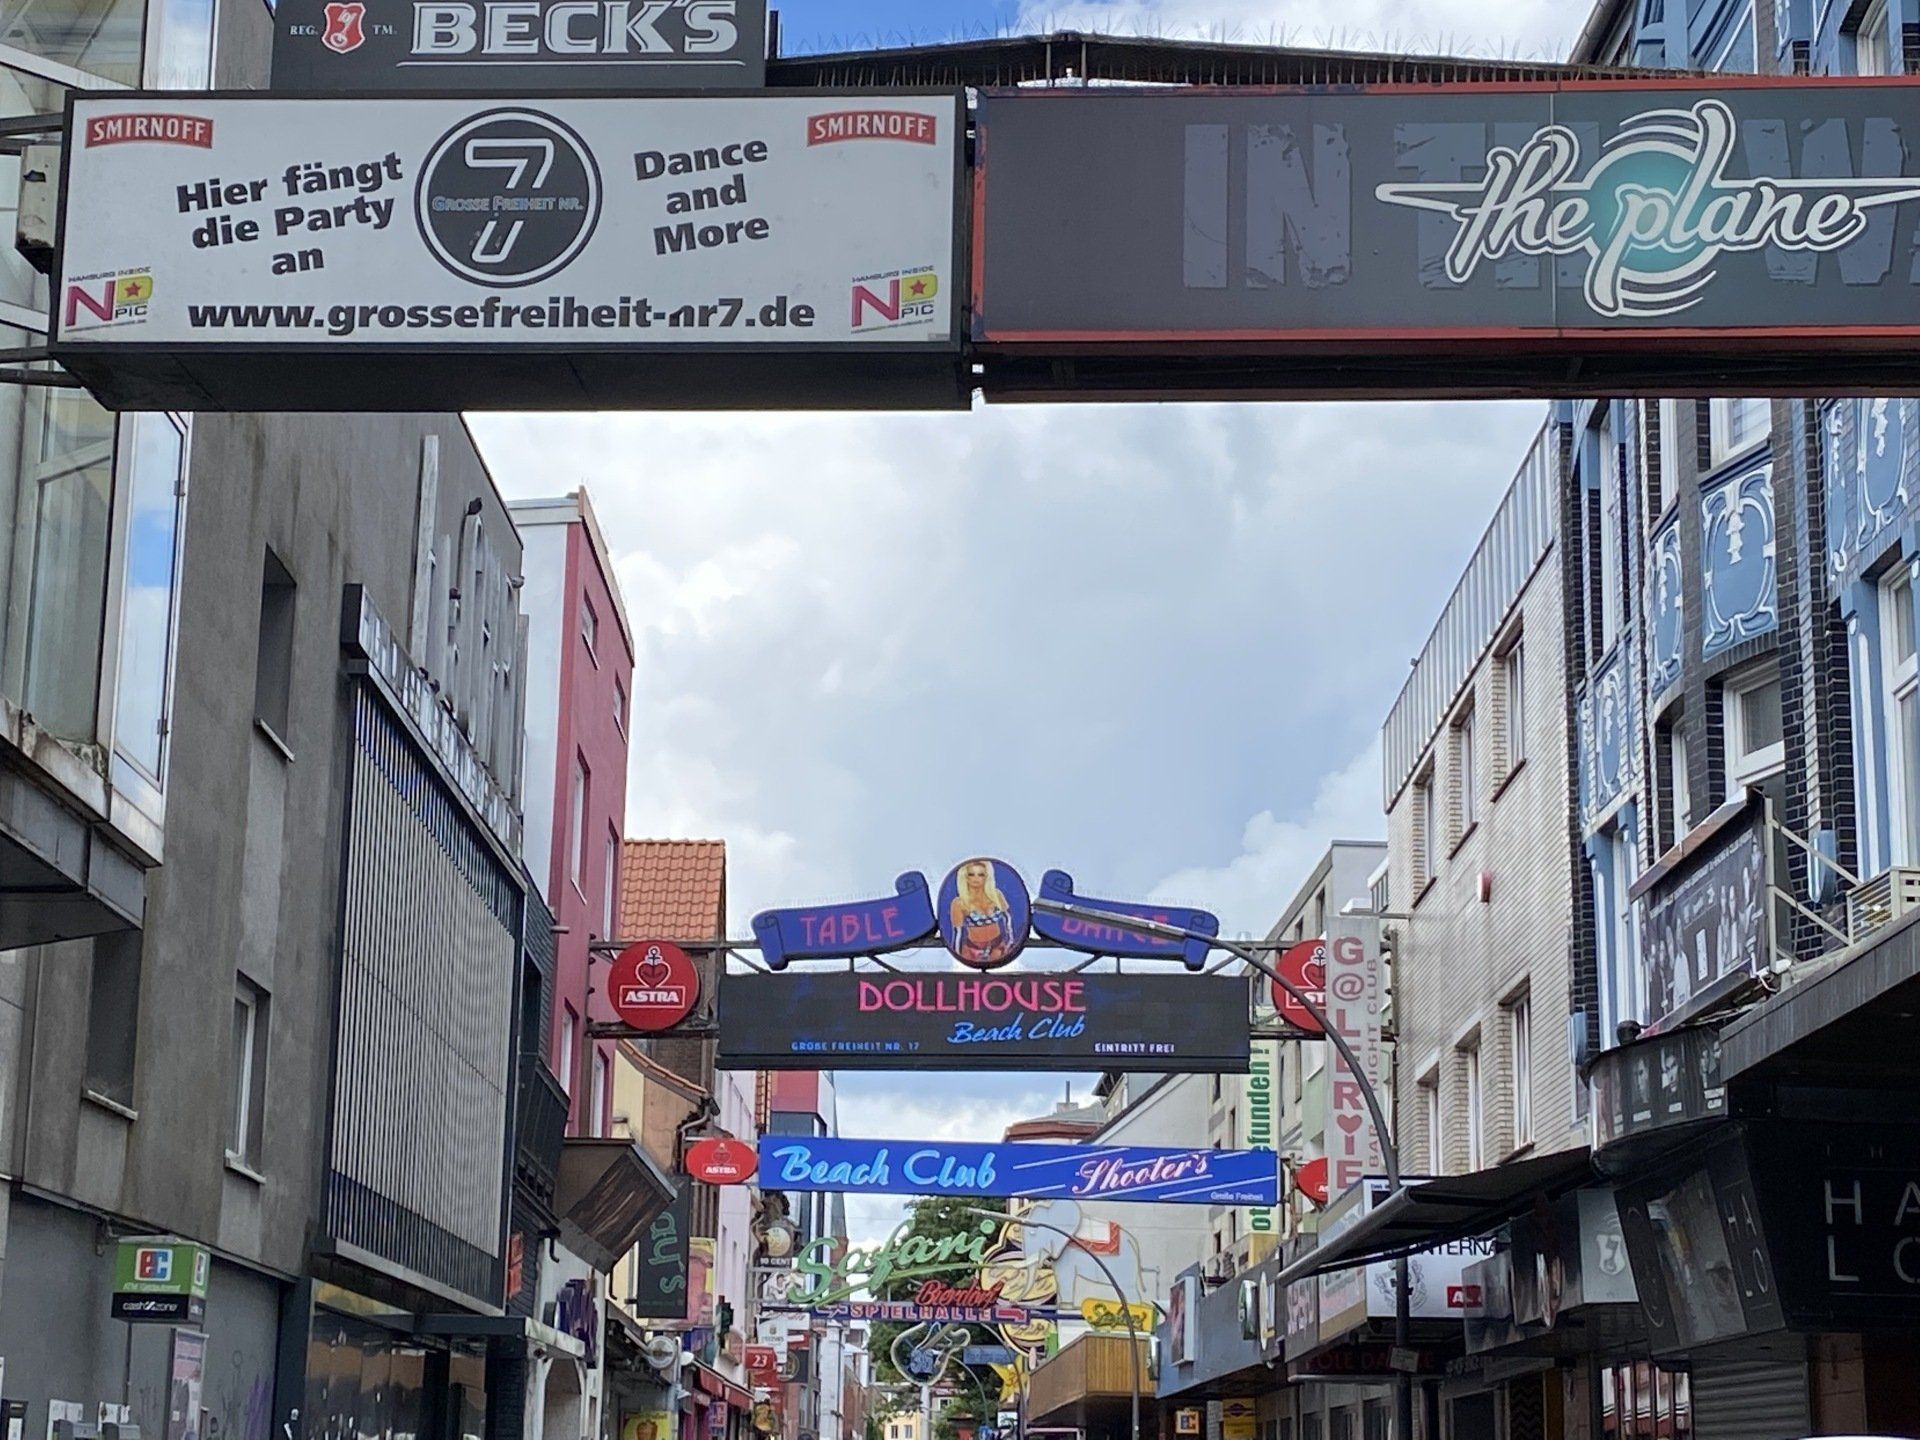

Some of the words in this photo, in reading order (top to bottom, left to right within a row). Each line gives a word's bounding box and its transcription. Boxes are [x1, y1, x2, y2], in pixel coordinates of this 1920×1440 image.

[410, 0, 738, 54] BECK'S
[92, 116, 207, 142] SMIRNOFF
[814, 113, 928, 140] SMIRNOFF
[634, 139, 769, 181] Dance
[176, 178, 269, 214] Hier
[282, 151, 403, 197] fängt
[666, 174, 748, 215] and
[191, 217, 260, 249] die
[274, 195, 395, 238] Party
[1184, 122, 1352, 290] IN
[1445, 126, 1592, 283] the
[1586, 99, 1867, 318] plane
[653, 216, 770, 256] More
[270, 246, 325, 276] an
[188, 296, 816, 337] www.grossefreiheit-nr7.de
[800, 907, 905, 947] TABLE
[625, 990, 680, 1004] ASTRA
[859, 980, 1086, 1013] DOLLHOUSE
[1367, 958, 1378, 1016] CLUB
[947, 1012, 1023, 1044] Beach
[1028, 1013, 1086, 1040] Club
[1094, 1042, 1146, 1053] EINTRITT
[1149, 1042, 1175, 1054] FREI
[1367, 1025, 1379, 1092] NIGHT
[705, 1165, 738, 1176] ASTRA
[771, 1145, 890, 1187] Beach
[903, 1148, 997, 1188] Club
[1072, 1153, 1208, 1194] Shooter's
[788, 1218, 995, 1303] Safari
[850, 1304, 992, 1322] SPIELHALLE
[752, 1354, 768, 1367] 23
